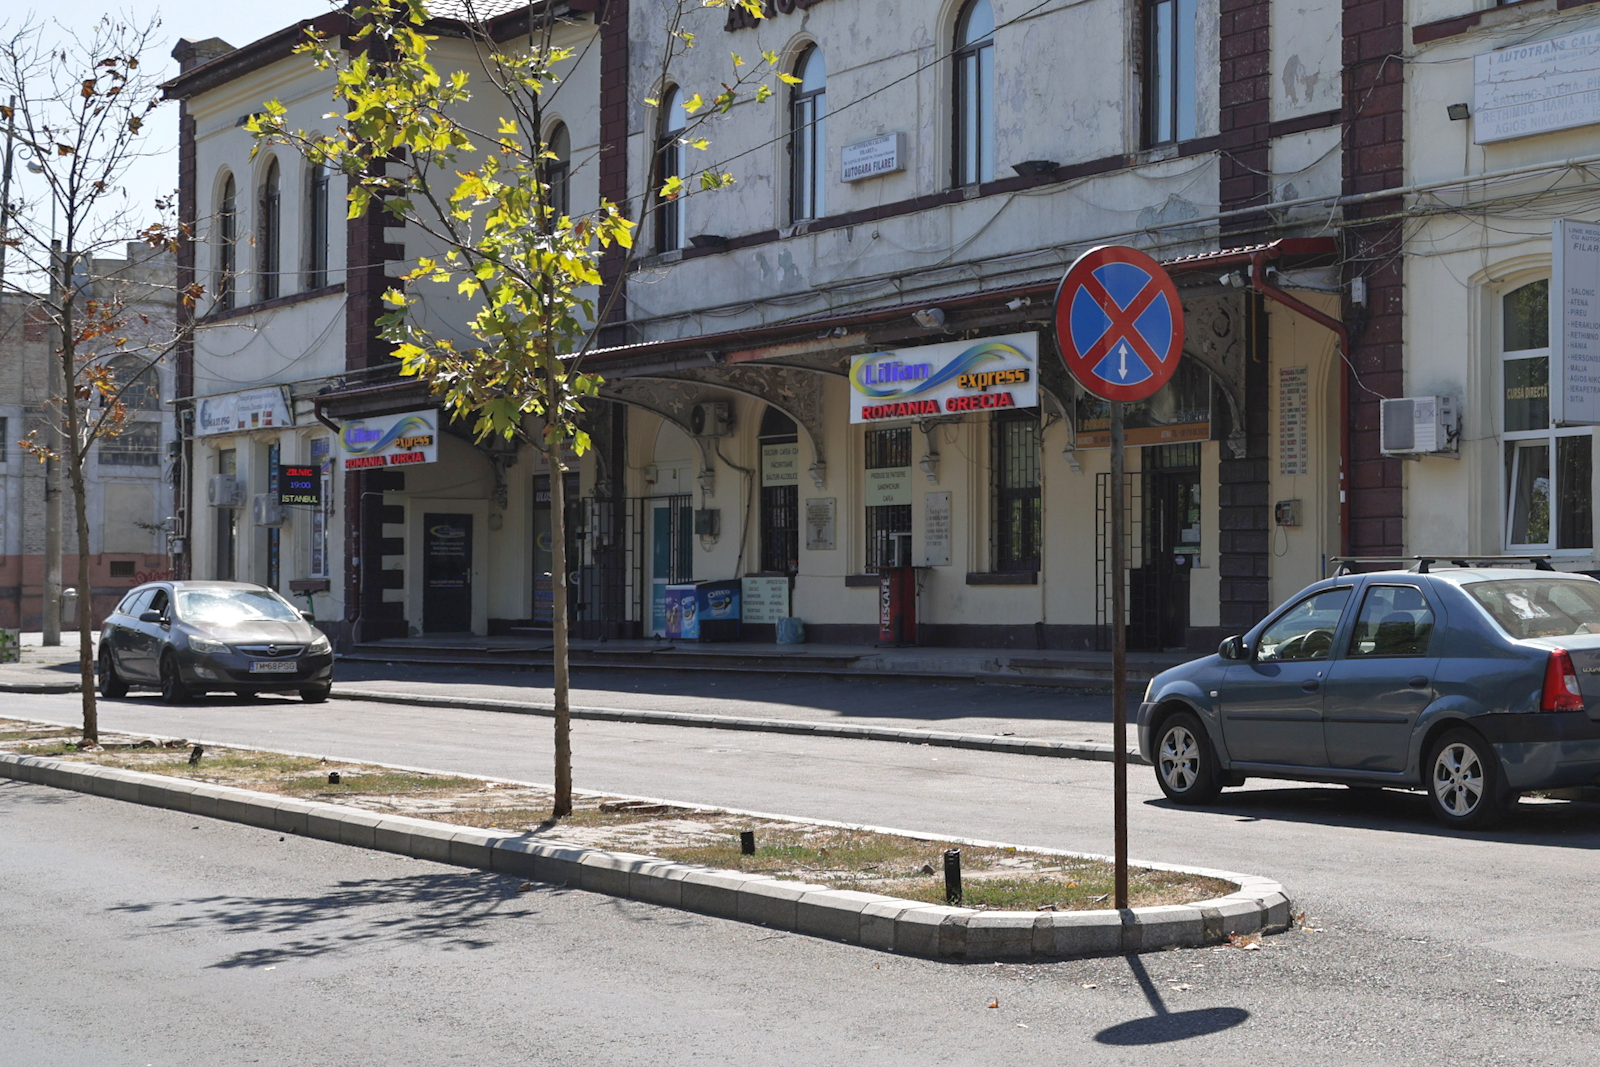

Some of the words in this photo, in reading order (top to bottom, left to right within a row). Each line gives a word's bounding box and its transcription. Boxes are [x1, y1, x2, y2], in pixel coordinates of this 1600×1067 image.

[1497, 40, 1566, 64] AUTOTRANS
[1495, 119, 1527, 134] AGIOS
[844, 163, 871, 178] AUTOGARA
[873, 157, 894, 171] FILARET
[865, 361, 931, 384] Lilian
[957, 368, 1030, 391] express
[862, 399, 940, 419] ROMANIA
[945, 392, 1015, 412] GRECIA
[346, 427, 382, 444] Lilian
[394, 435, 433, 451] express
[345, 455, 387, 469] ROMANIA
[388, 451, 426, 465] TURCIA
[286, 468, 313, 476] ZILNIC
[290, 481, 312, 489] 19:00
[708, 589, 731, 599] OREO
